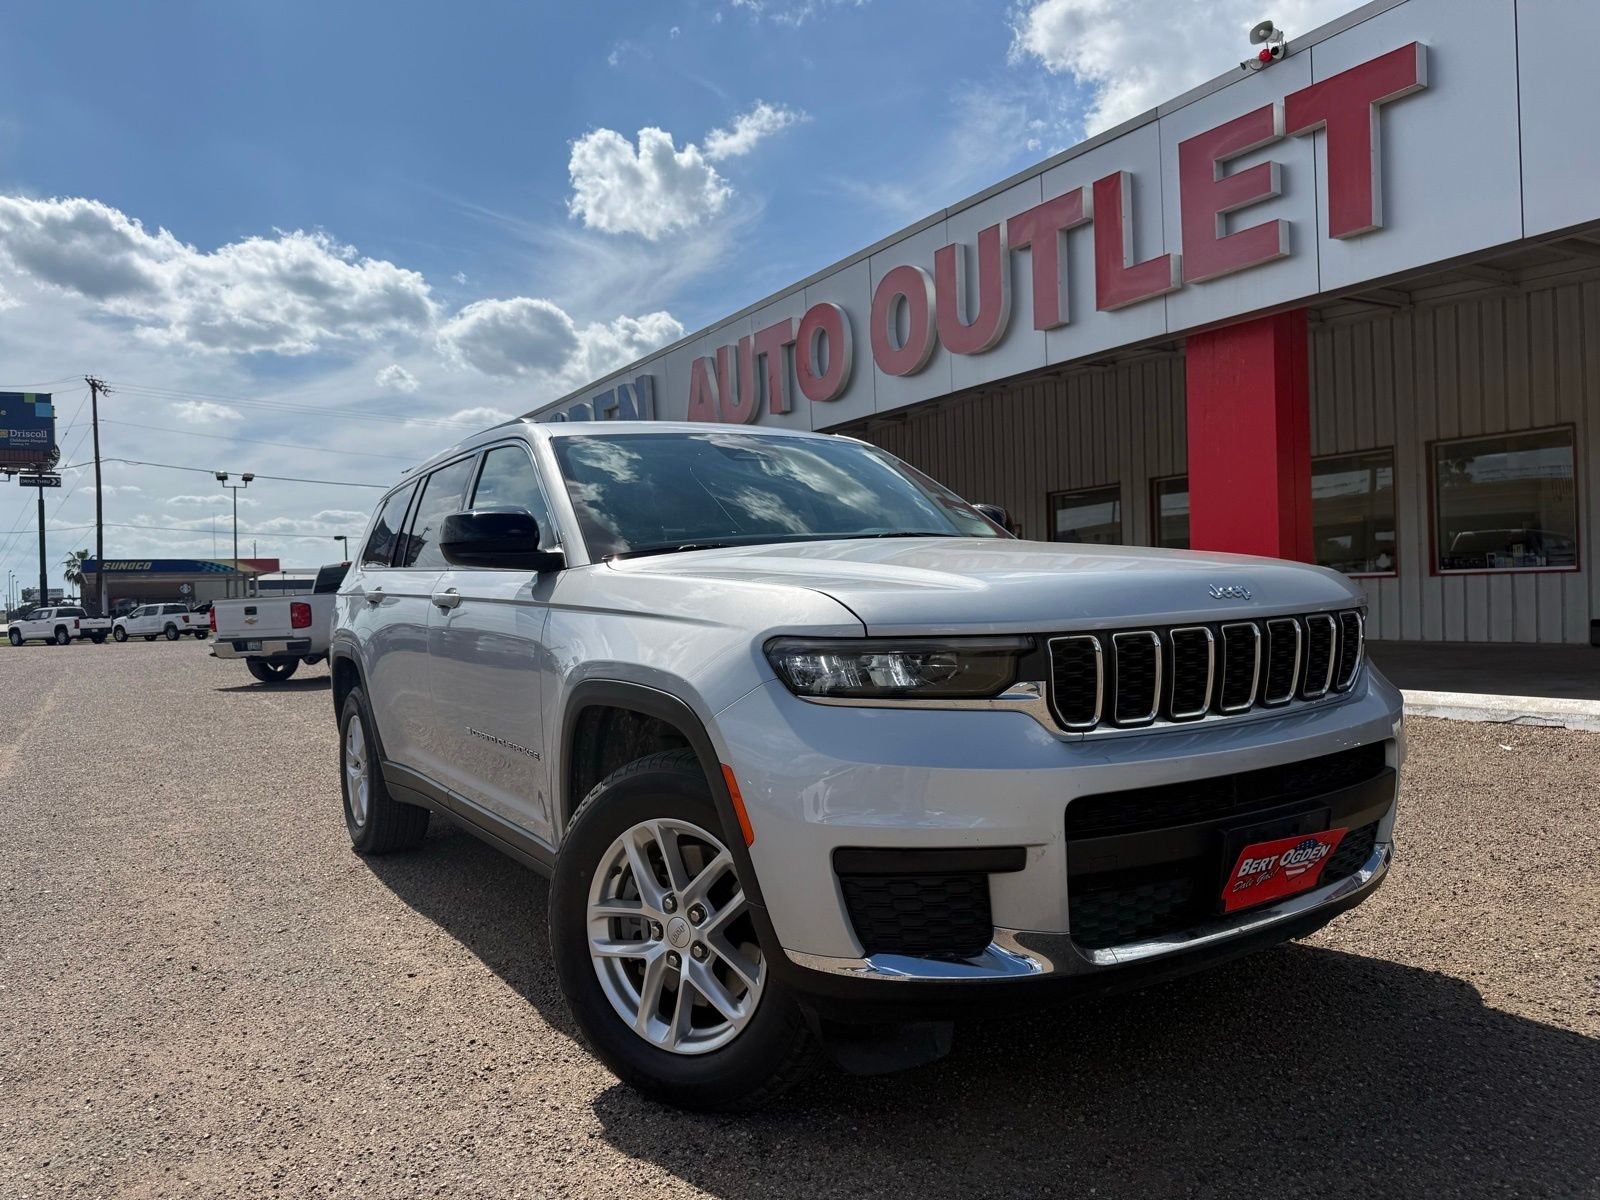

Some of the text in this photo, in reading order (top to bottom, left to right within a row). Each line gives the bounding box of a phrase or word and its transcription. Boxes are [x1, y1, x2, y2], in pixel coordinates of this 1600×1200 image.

[687, 302, 853, 425] AUTO
[870, 41, 1428, 377] OUTLET
[9, 429, 48, 438] Driscoll
[102, 561, 152, 570] SUNOCO
[1208, 583, 1252, 601] Jeep
[1237, 843, 1331, 878] BERT OGDEN
